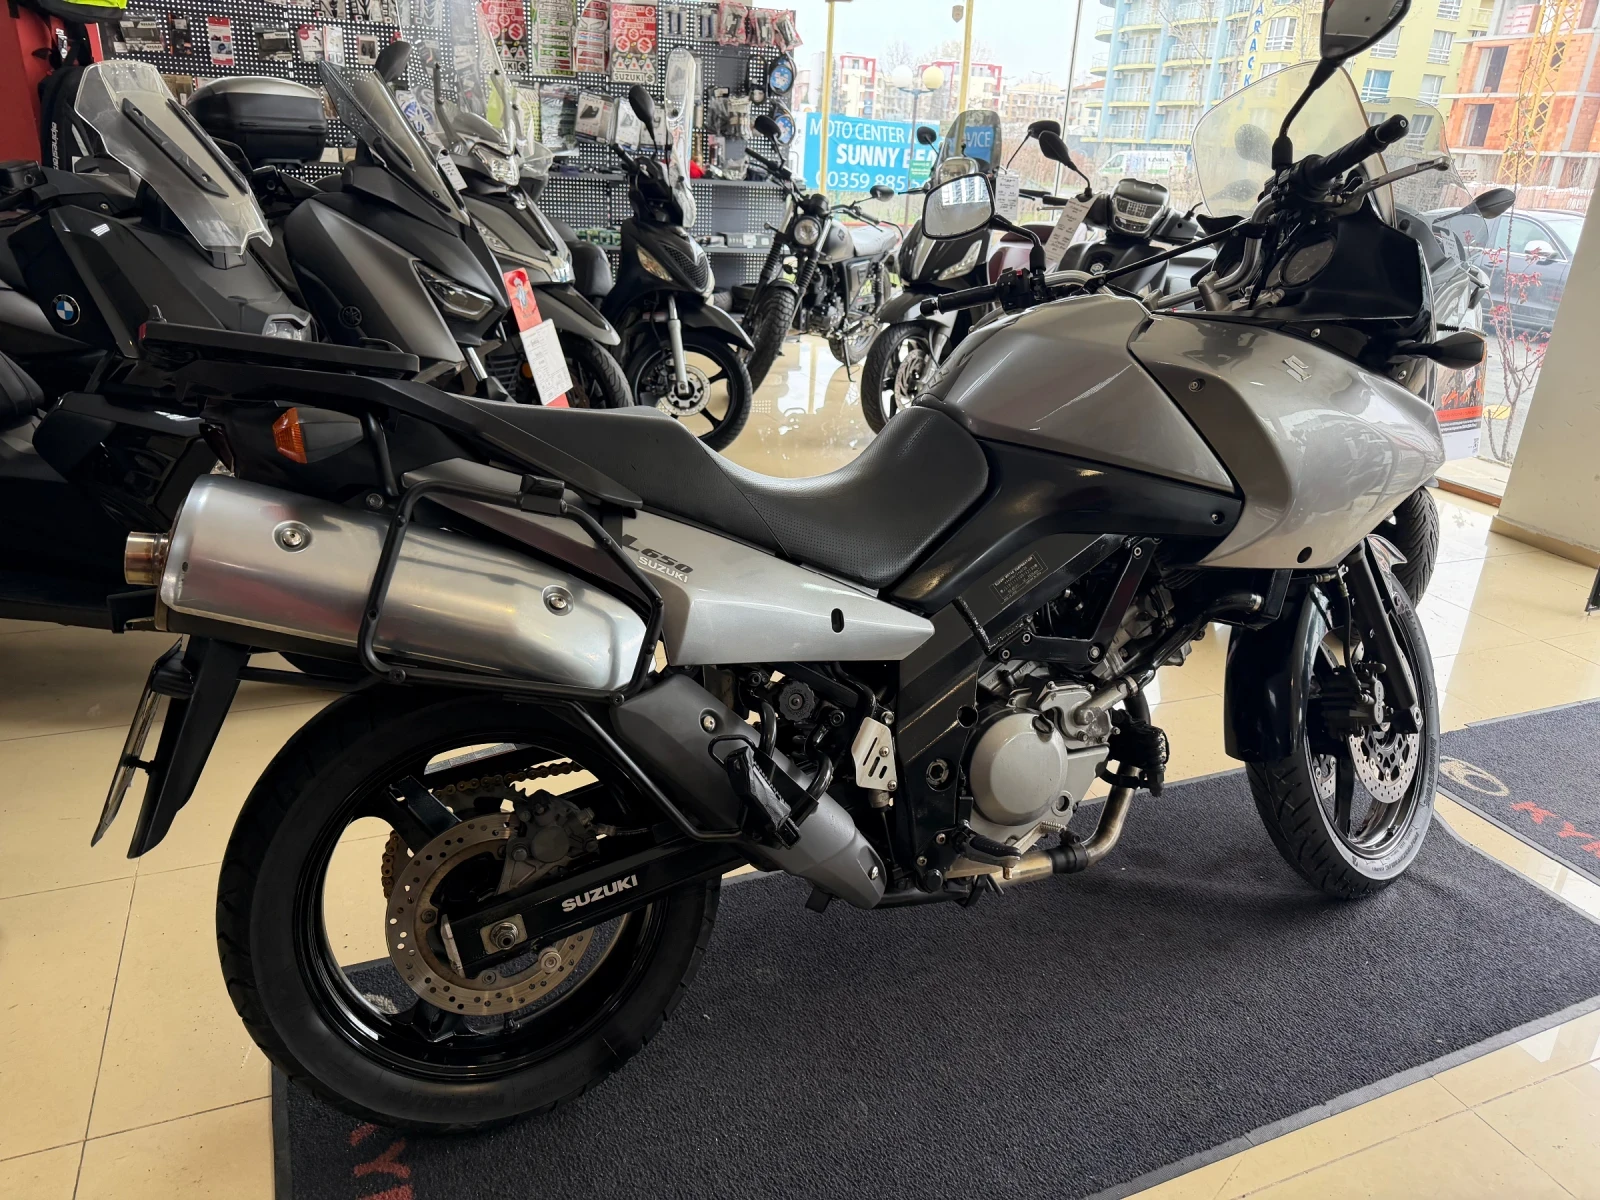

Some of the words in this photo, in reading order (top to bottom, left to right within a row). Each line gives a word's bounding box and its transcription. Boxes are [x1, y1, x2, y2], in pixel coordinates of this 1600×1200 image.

[614, 73, 645, 82] SUZUKI
[855, 123, 905, 144] CENTER
[836, 143, 900, 168] SUNNY
[874, 174, 906, 191] 885
[638, 556, 689, 583] SUZUKI
[561, 874, 639, 912] SUZUKI
